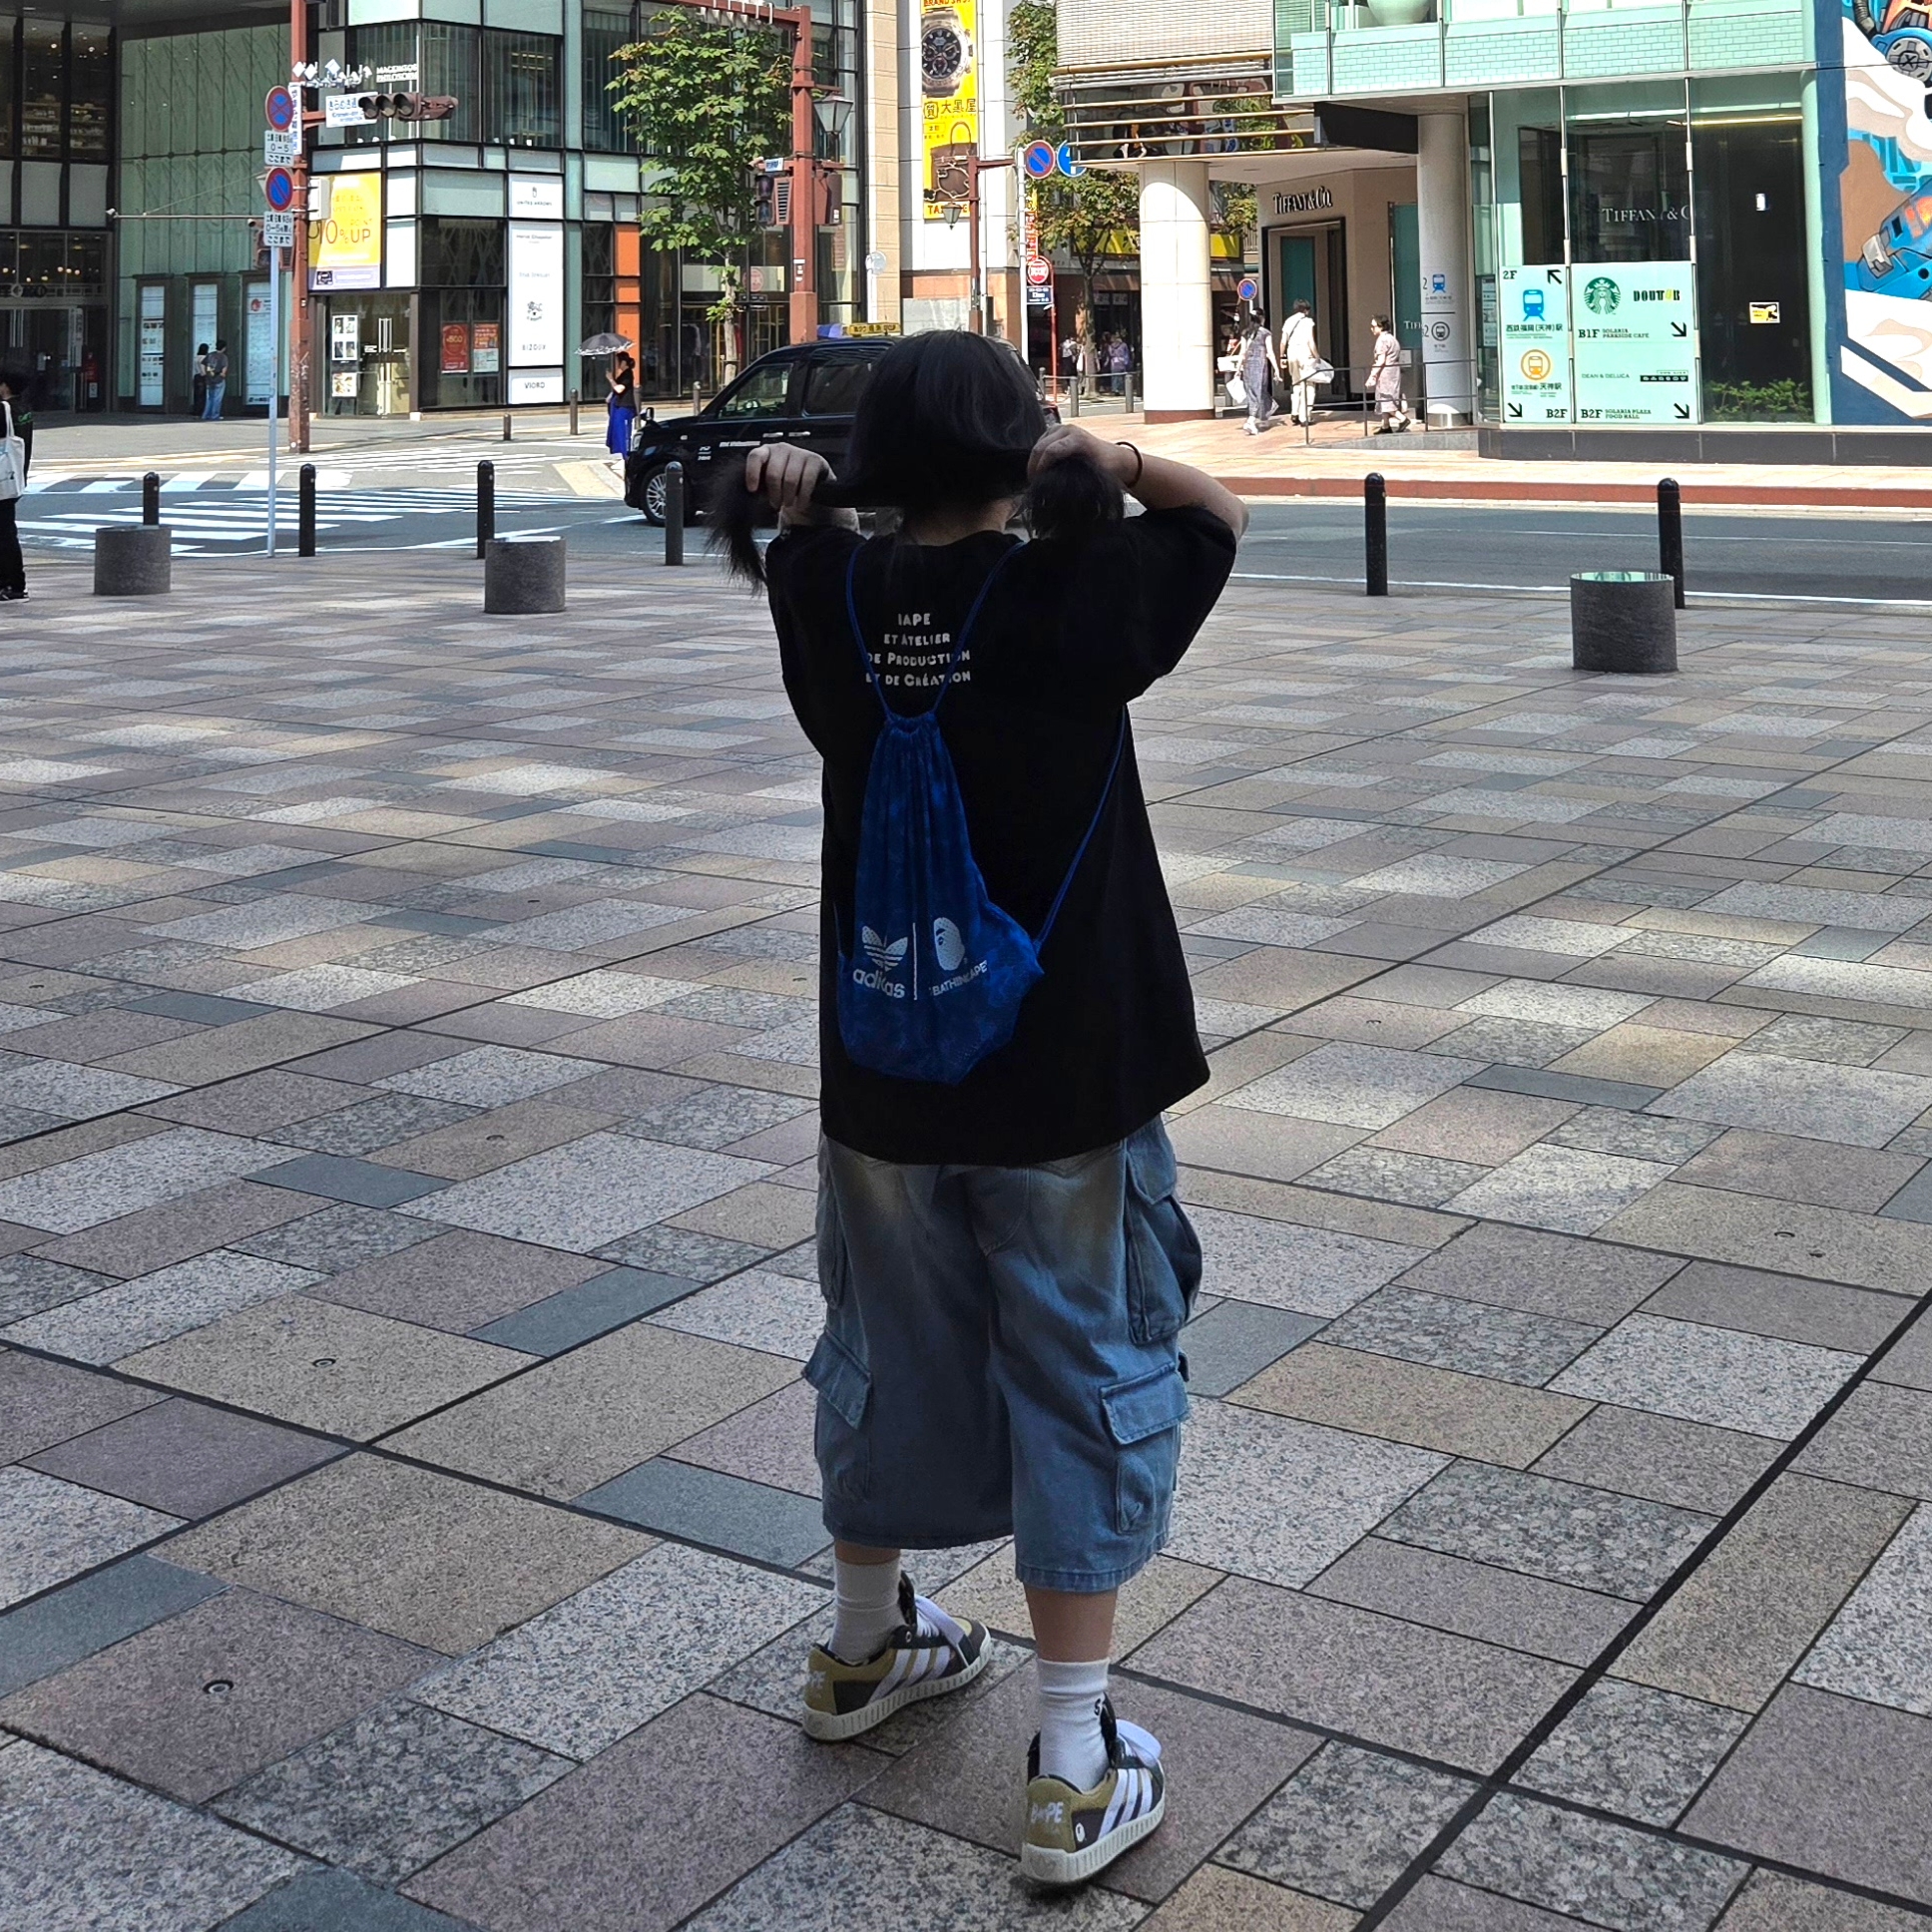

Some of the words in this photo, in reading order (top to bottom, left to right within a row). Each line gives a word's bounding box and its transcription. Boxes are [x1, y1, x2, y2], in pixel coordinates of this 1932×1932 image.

[328, 97, 357, 112] きらめき通
[940, 98, 976, 115] 大黒屋
[267, 155, 290, 164] ここまで
[267, 236, 290, 244] ここまで
[350, 228, 371, 243] UP
[1502, 269, 1518, 280] 2F
[1633, 288, 1681, 301] DOUTOR
[1578, 328, 1600, 338] B1F
[1546, 408, 1568, 419] B2F
[1580, 408, 1603, 419] B2F
[901, 633, 951, 647] ATELIER
[885, 675, 900, 687] DE
